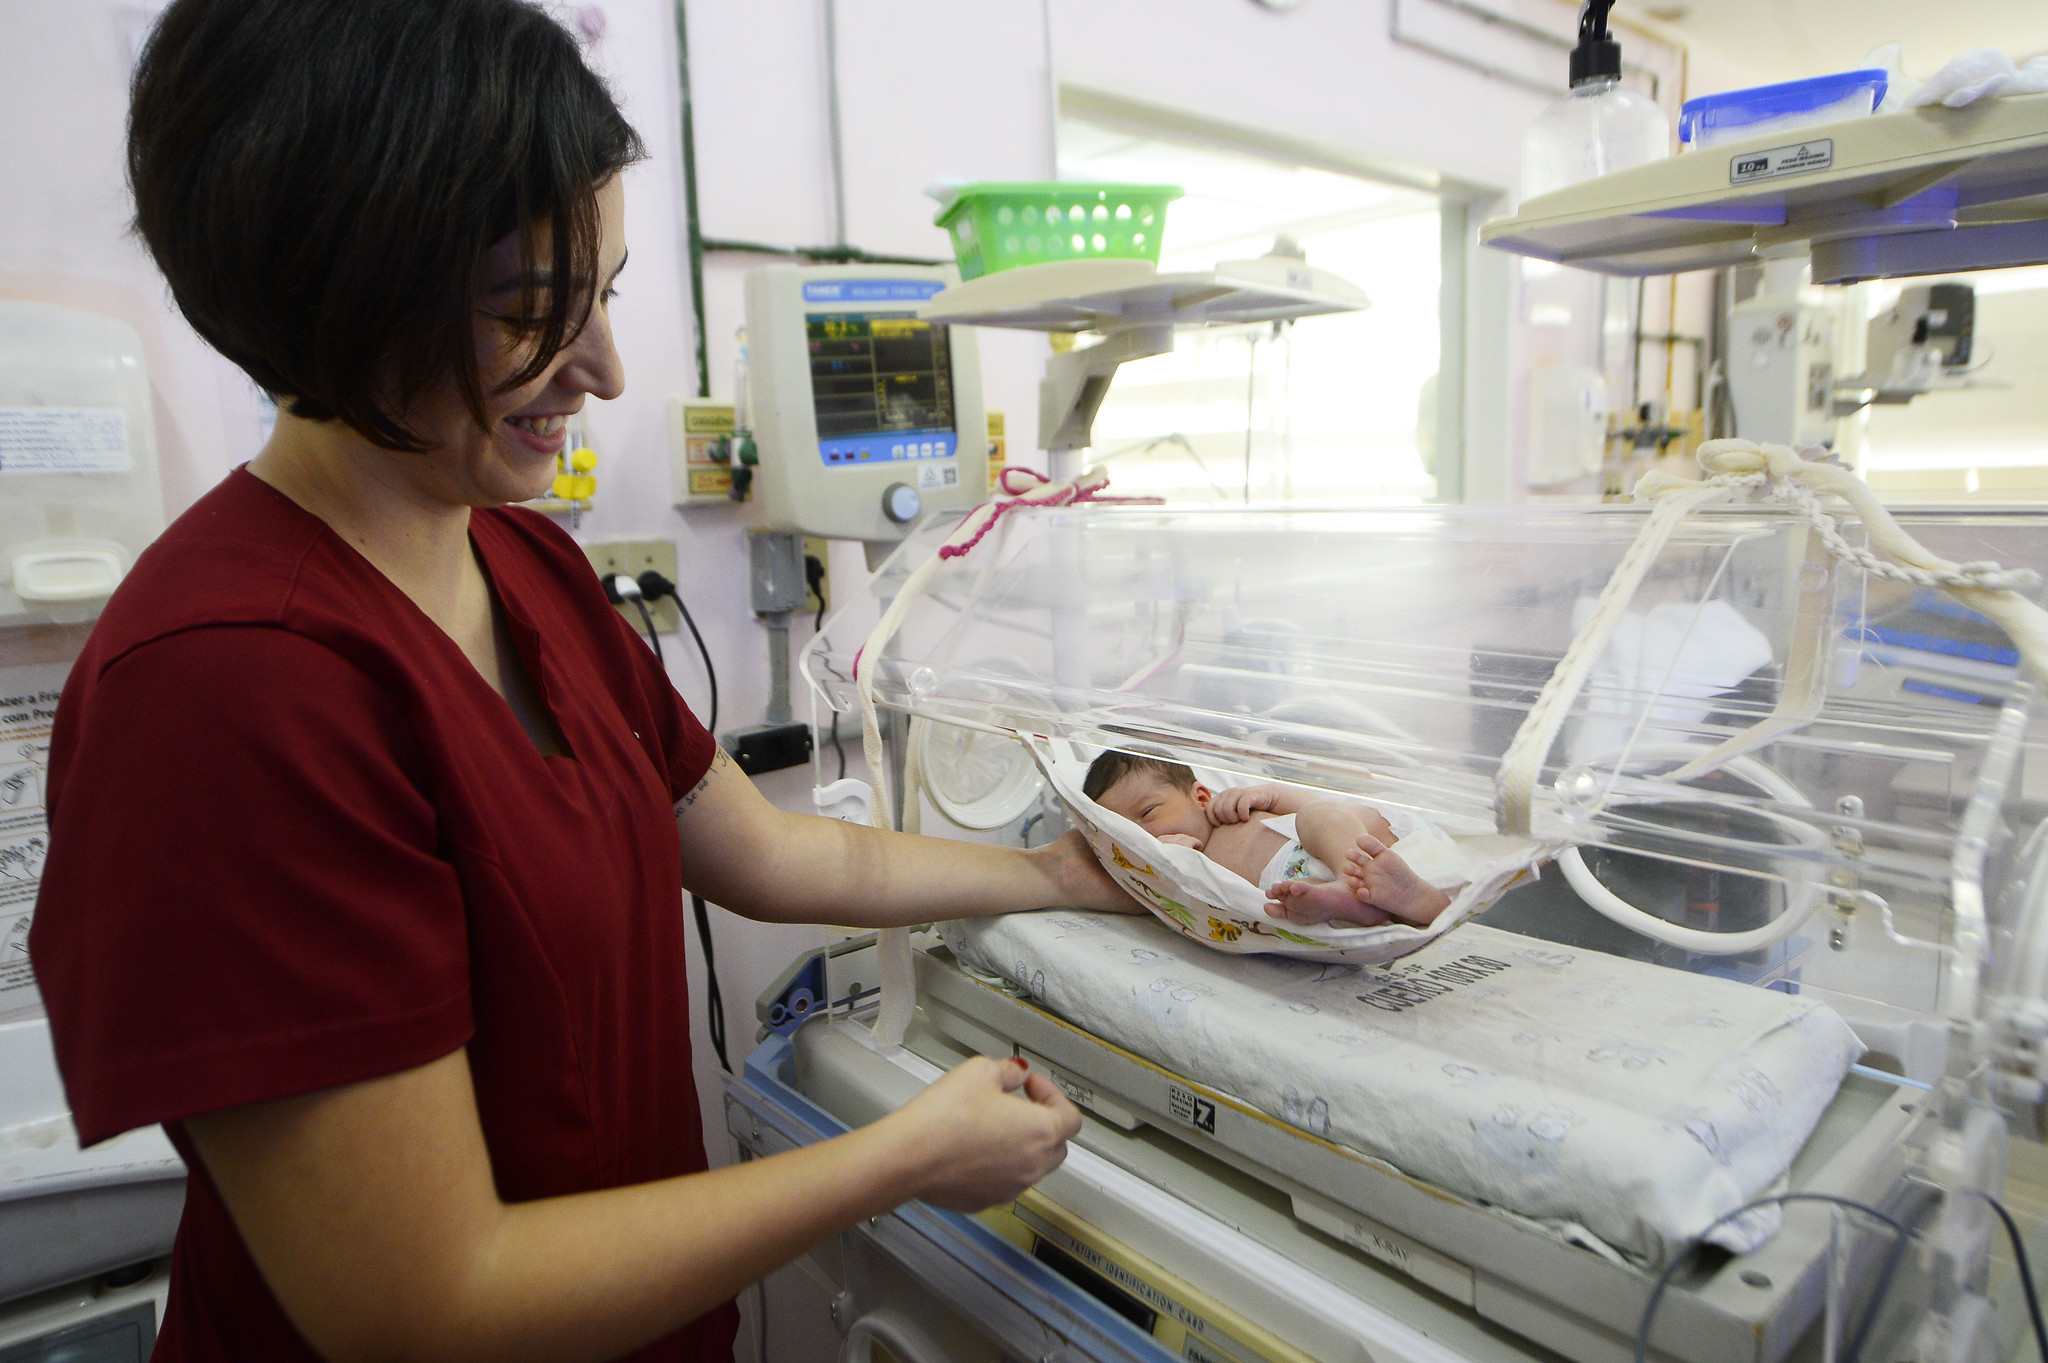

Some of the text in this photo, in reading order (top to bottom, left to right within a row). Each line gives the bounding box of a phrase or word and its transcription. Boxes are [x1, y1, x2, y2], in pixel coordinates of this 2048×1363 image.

[1741, 162, 1755, 172] 10
[2, 712, 30, 724] com
[1355, 977, 1455, 1012] CUEIRO
[1070, 1239, 1205, 1332] PATIENT IDENTIFICATION CARD
